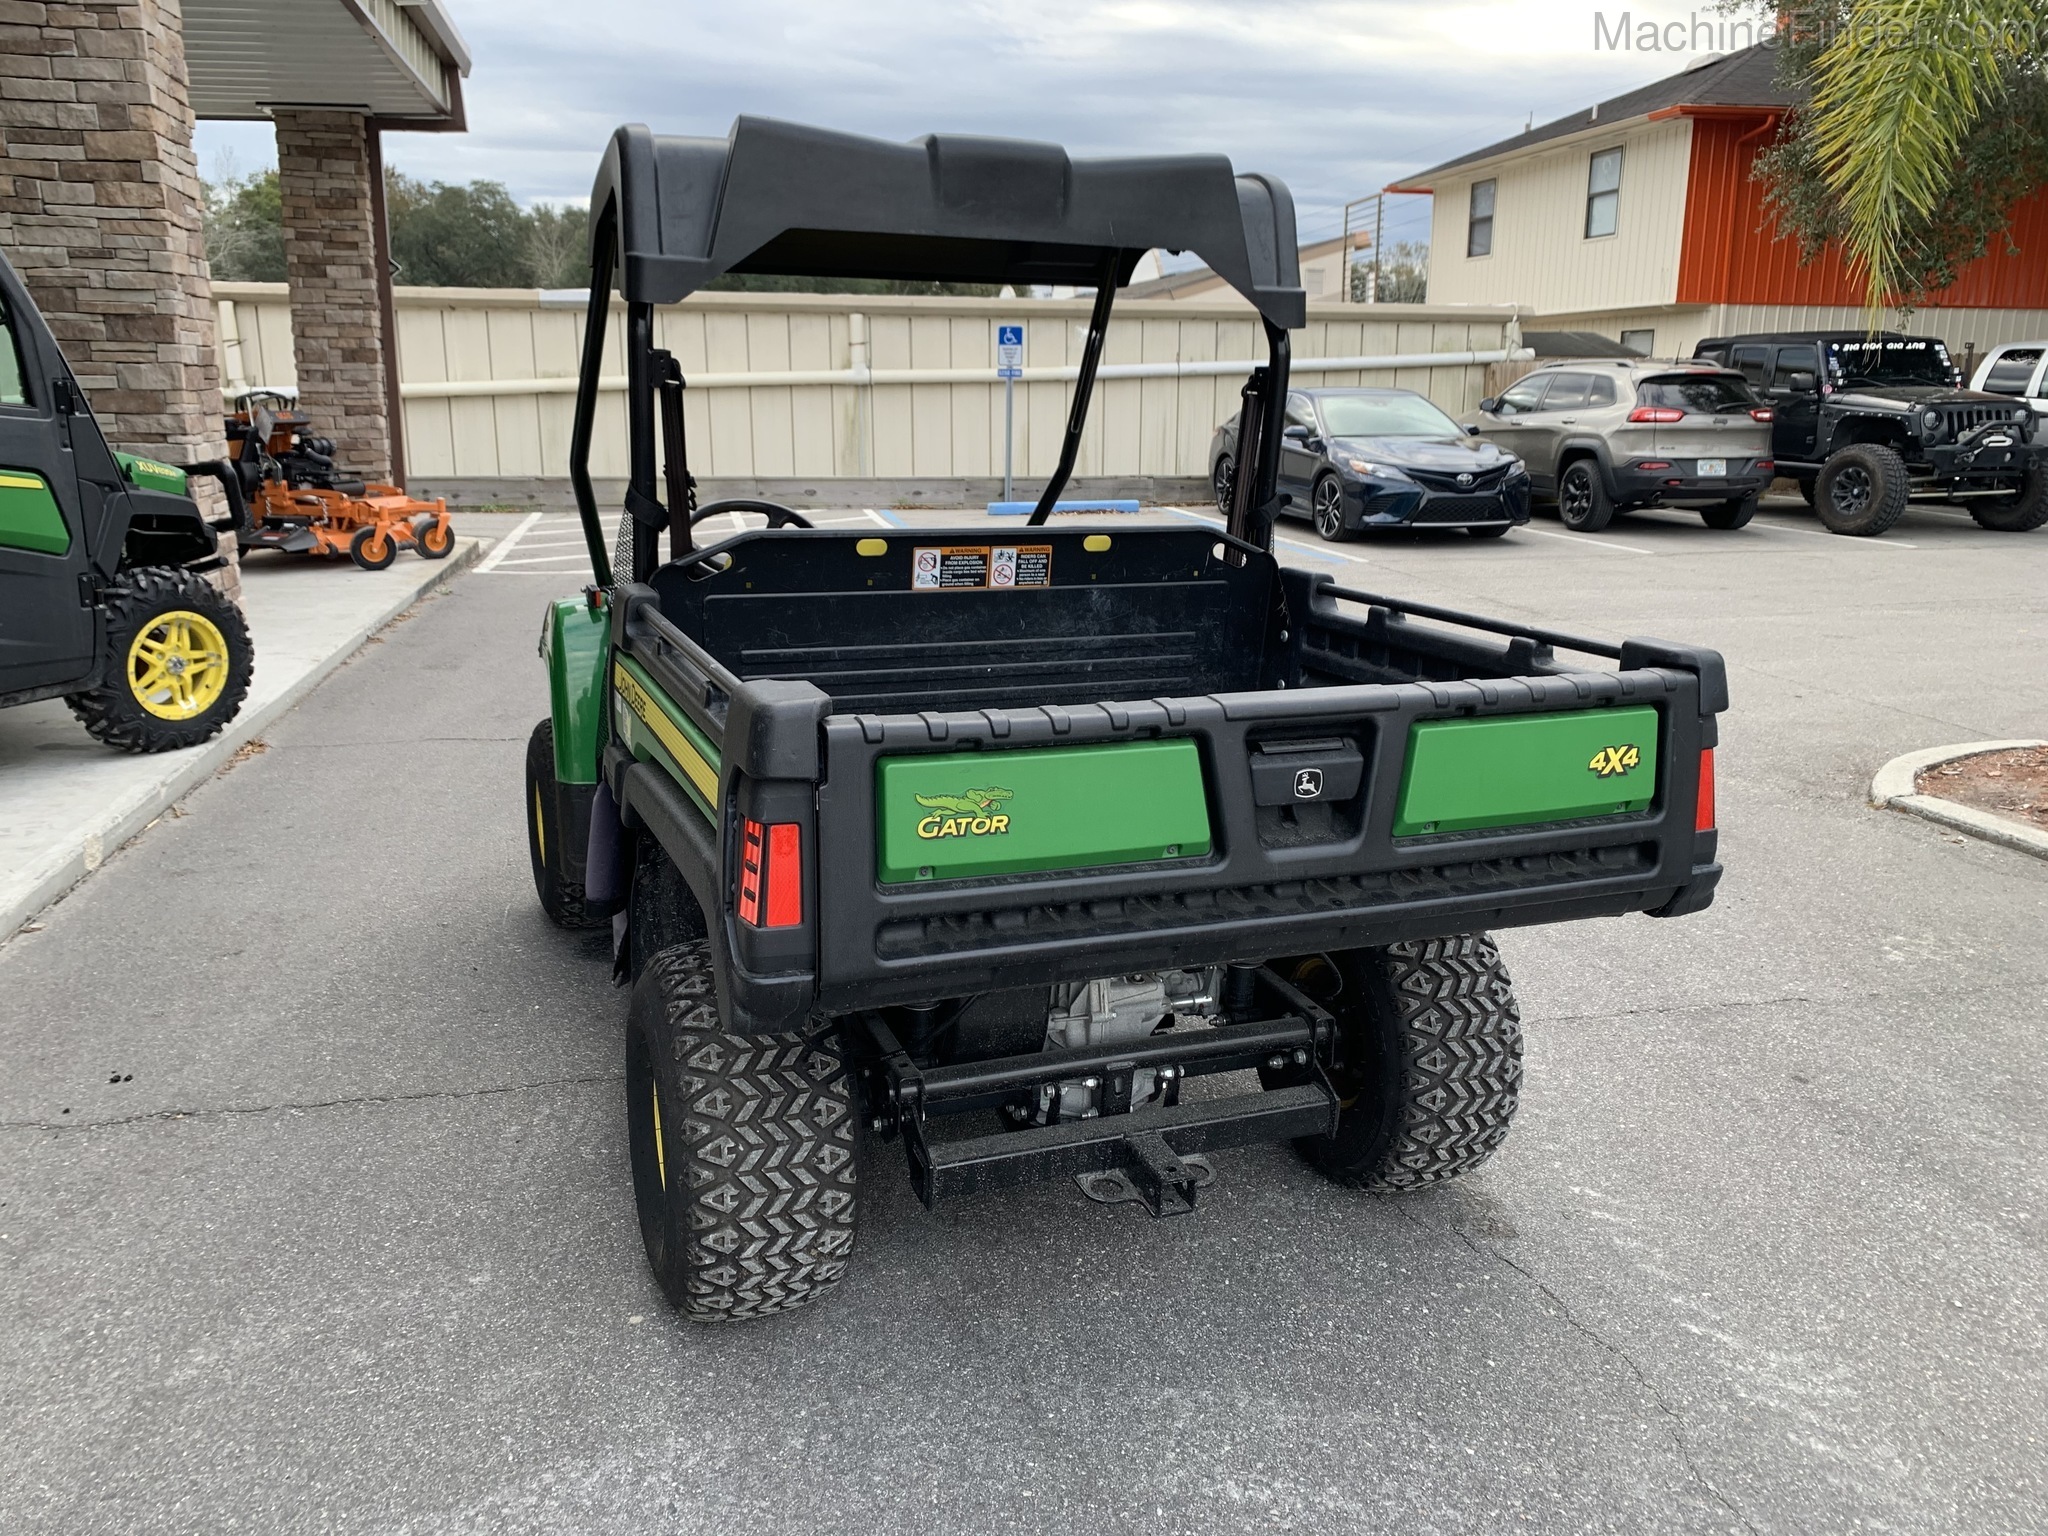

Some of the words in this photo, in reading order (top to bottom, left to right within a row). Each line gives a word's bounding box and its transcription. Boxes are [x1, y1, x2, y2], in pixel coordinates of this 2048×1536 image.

[1886, 342, 1904, 350] DID
[1905, 342, 1926, 350] BUT
[917, 815, 1010, 839] GATOR
